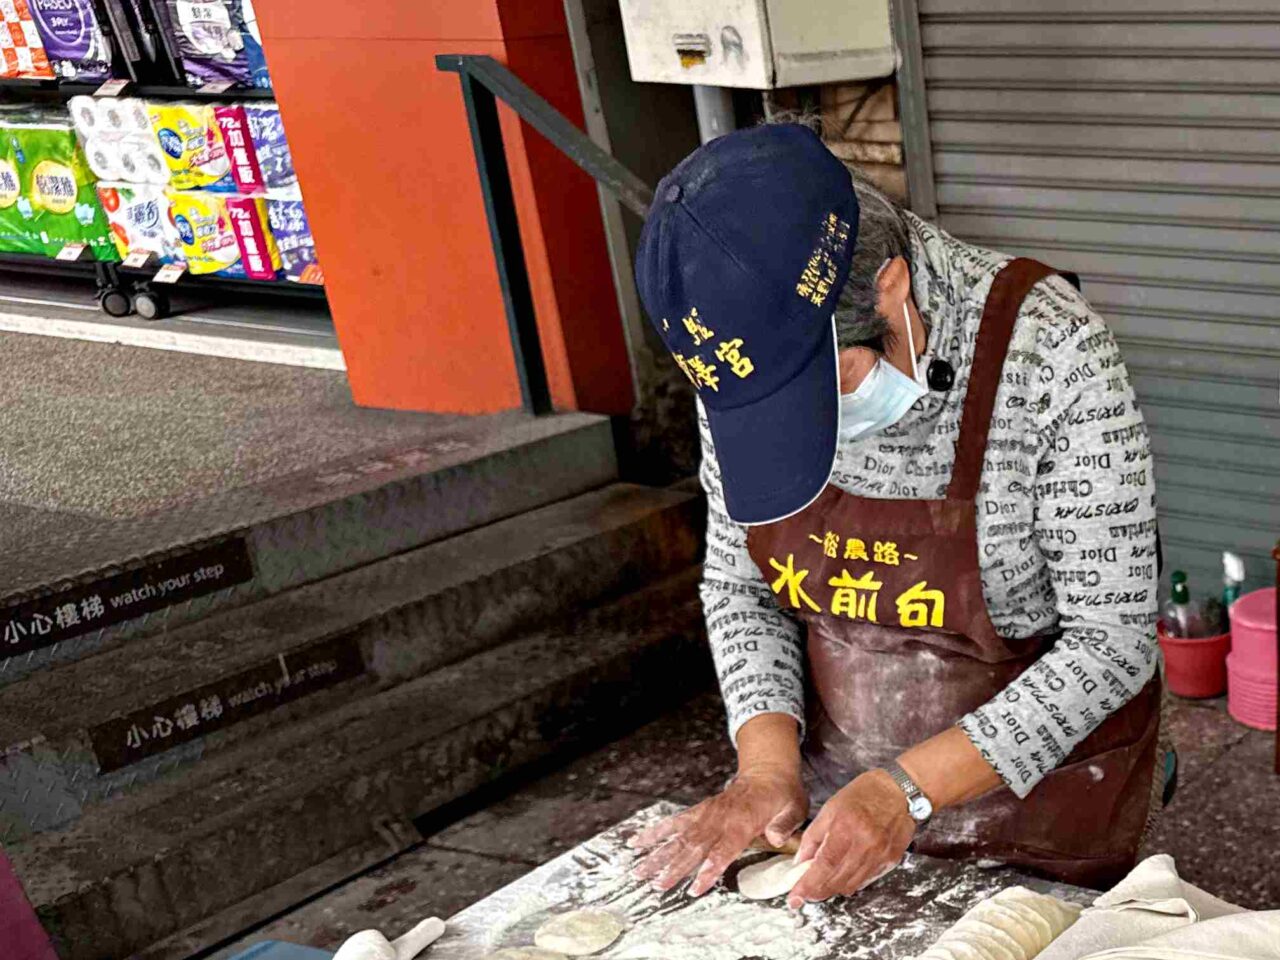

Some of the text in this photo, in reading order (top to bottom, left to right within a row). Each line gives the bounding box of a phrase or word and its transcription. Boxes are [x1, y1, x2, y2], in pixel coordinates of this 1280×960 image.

[1064, 363, 1096, 388] Dior
[864, 456, 895, 475] Dior
[1074, 453, 1111, 469] Dior
[1120, 470, 1146, 487] Dior
[889, 482, 919, 497] Dior
[1080, 547, 1117, 562] Dior
[1000, 555, 1035, 582] Dior
[1128, 564, 1153, 580] Dior
[4, 564, 225, 645] 小心樓梯 watch your step
[1027, 603, 1056, 622] Dio
[722, 640, 759, 657] Dior
[1065, 660, 1098, 695] Dior
[126, 694, 224, 749] 小心樓梯
[228, 682, 273, 708] watch
[1001, 712, 1030, 746] Dior
[1011, 757, 1033, 784] Dior
